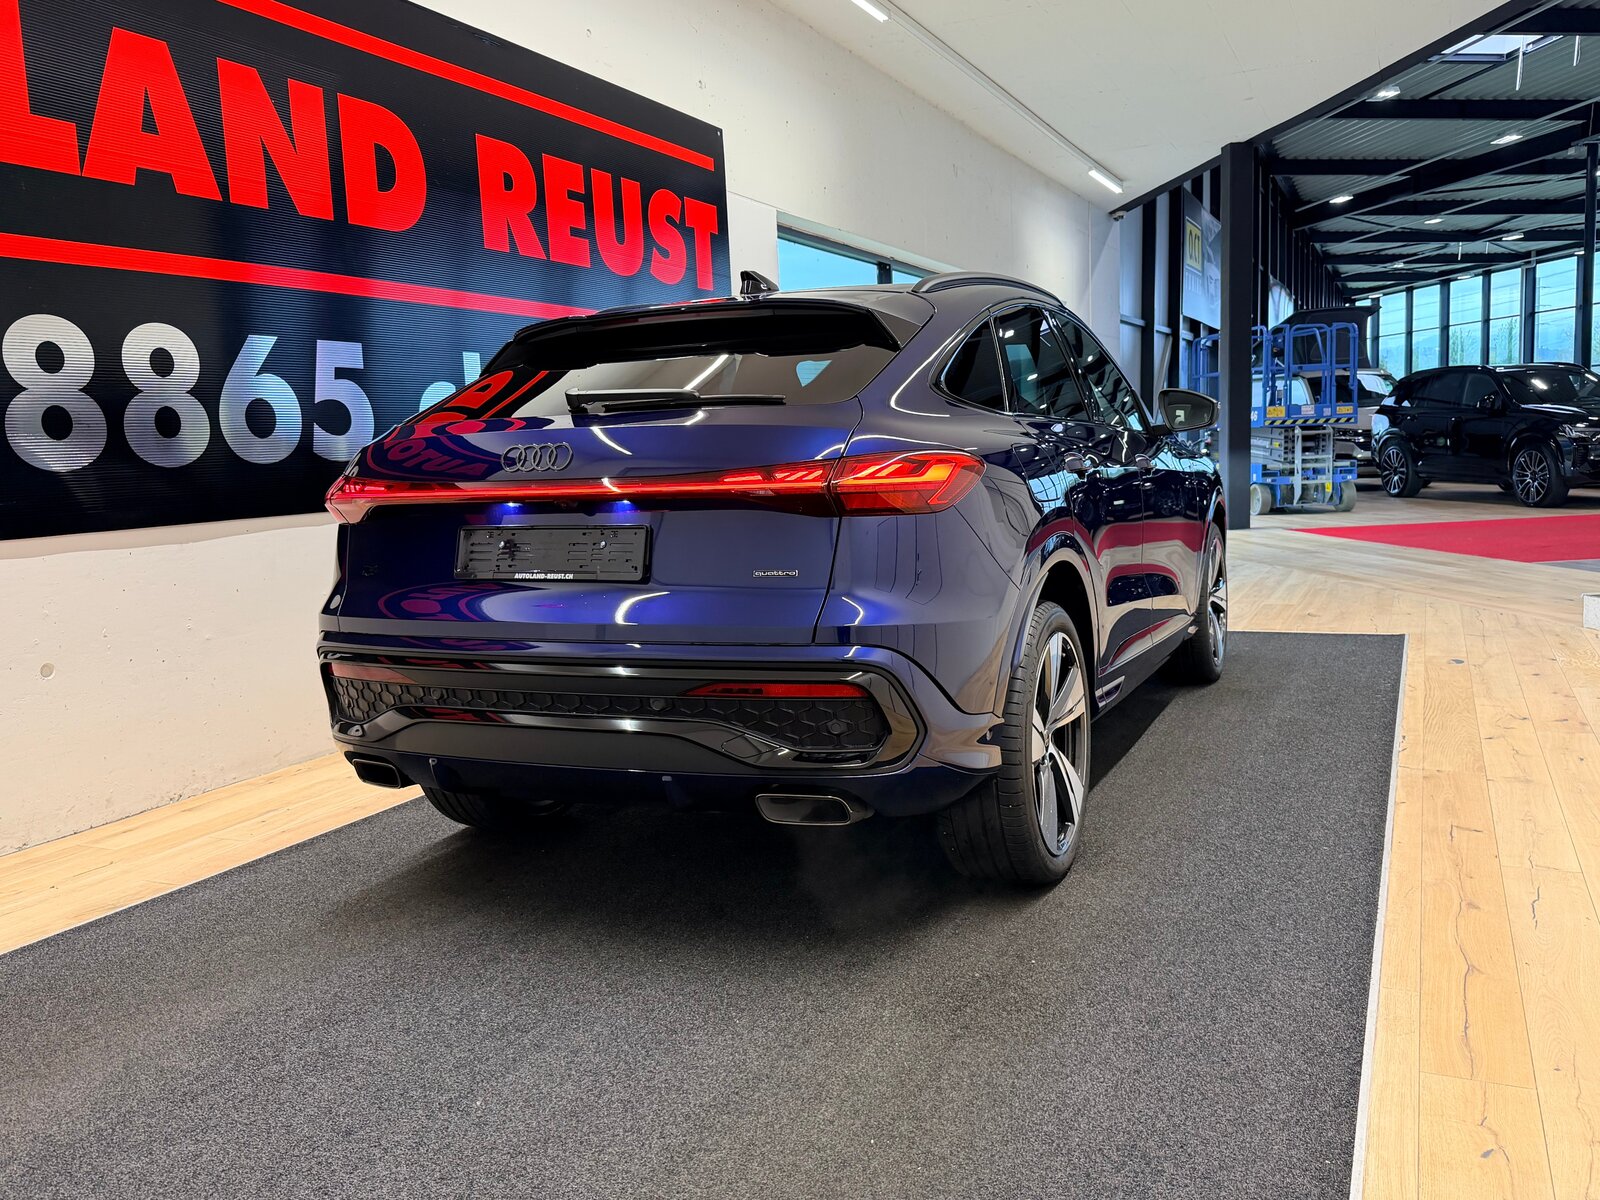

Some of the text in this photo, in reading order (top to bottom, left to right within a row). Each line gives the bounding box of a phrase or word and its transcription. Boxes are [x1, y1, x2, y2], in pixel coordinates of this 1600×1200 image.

[475, 133, 718, 290] REUST
[2, 314, 375, 472] 8865
[514, 572, 574, 580] AUTOLAND-REUST.CH
